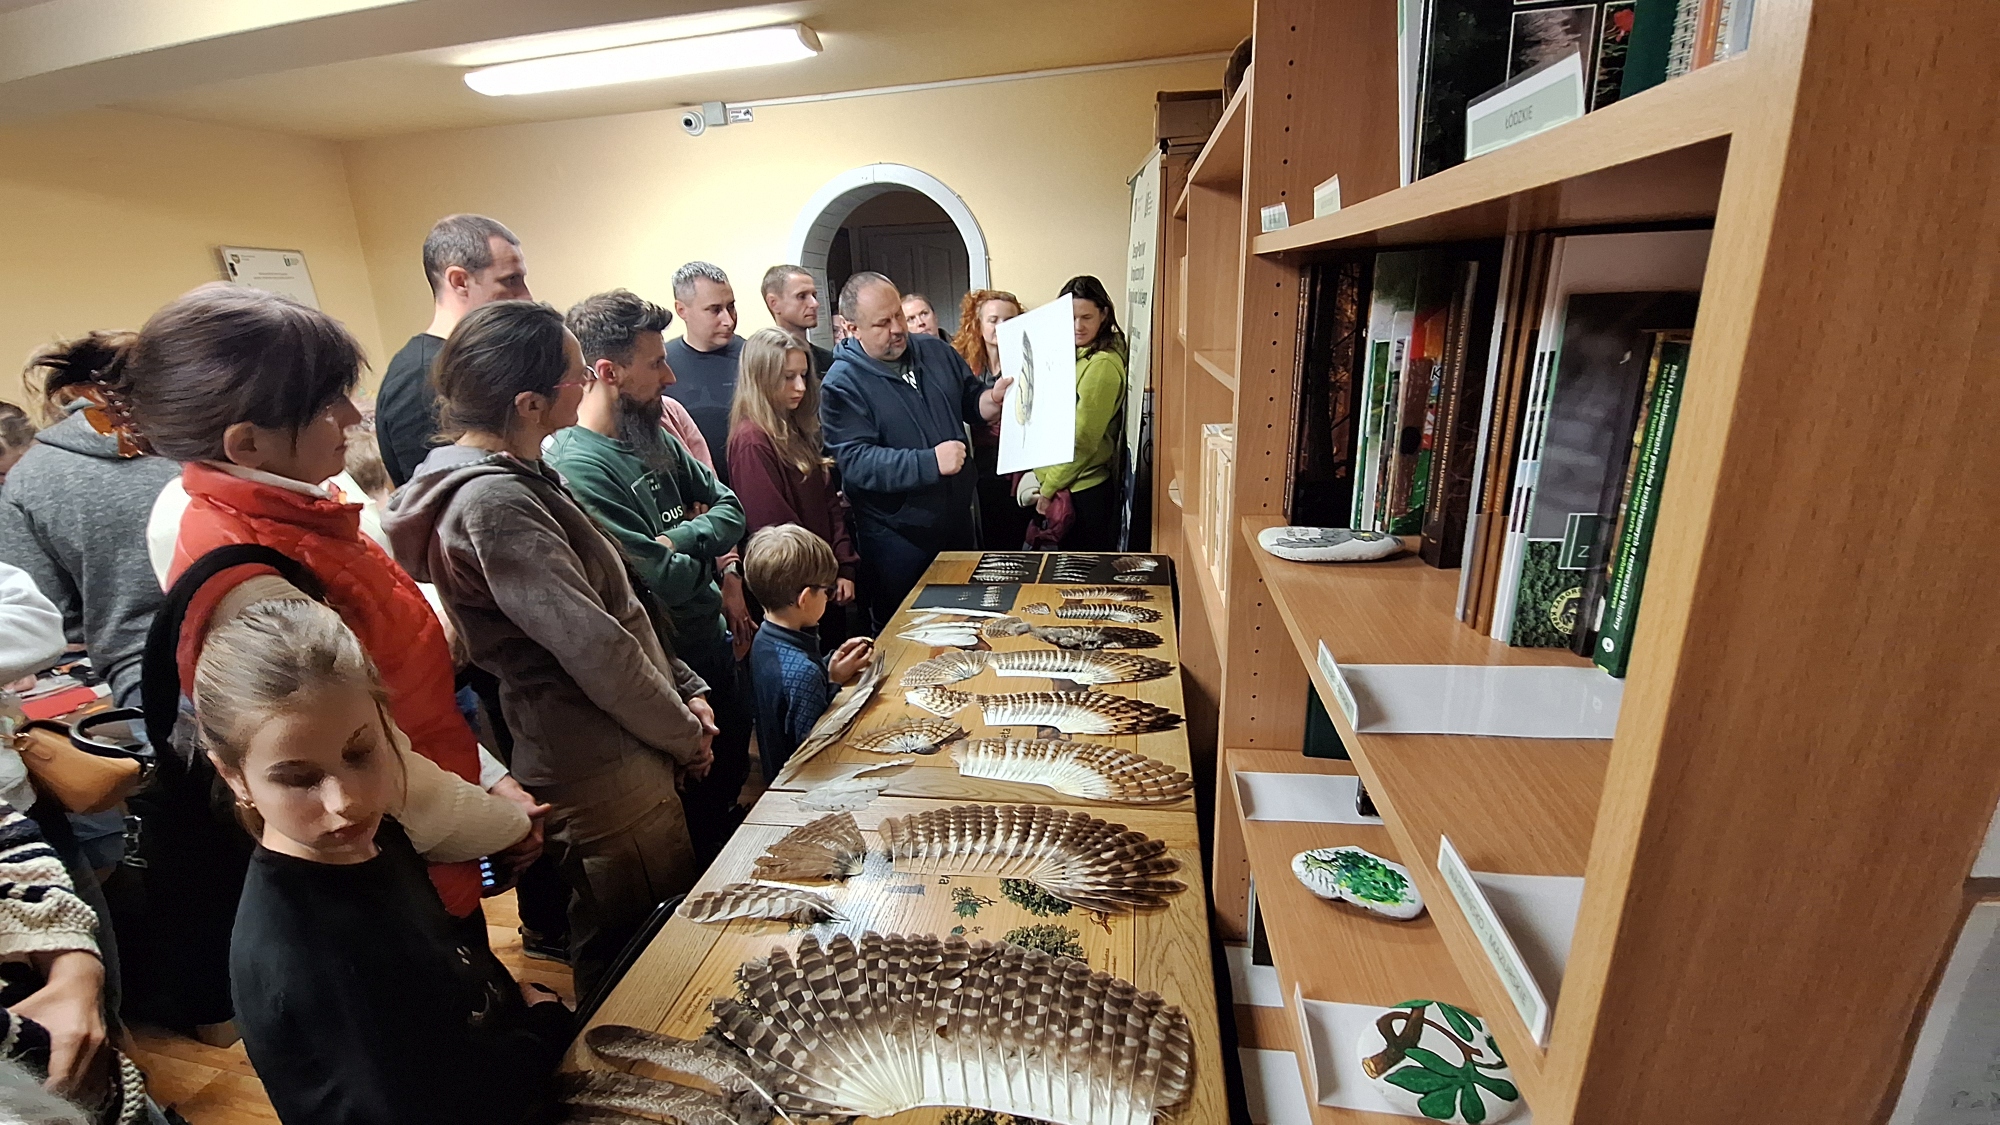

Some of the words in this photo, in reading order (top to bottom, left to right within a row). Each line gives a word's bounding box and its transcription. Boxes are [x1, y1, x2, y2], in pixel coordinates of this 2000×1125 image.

[1505, 104, 1533, 129] ŁÓDZKIE
[1662, 364, 1670, 378] The
[1668, 365, 1678, 383] Rola
[1658, 380, 1666, 396] role
[1653, 389, 1672, 455] funkcjonowanie
[1642, 415, 1659, 462] functioning
[1633, 472, 1645, 510] landscape
[661, 505, 684, 523] OUS
[1628, 511, 1637, 533] parks
[1632, 486, 1651, 546] krajobrazowych
[1618, 542, 1630, 578] biosphere
[1620, 555, 1635, 600] rezerwatach
[1611, 579, 1622, 609] reserves
[1613, 600, 1626, 631] biosfery
